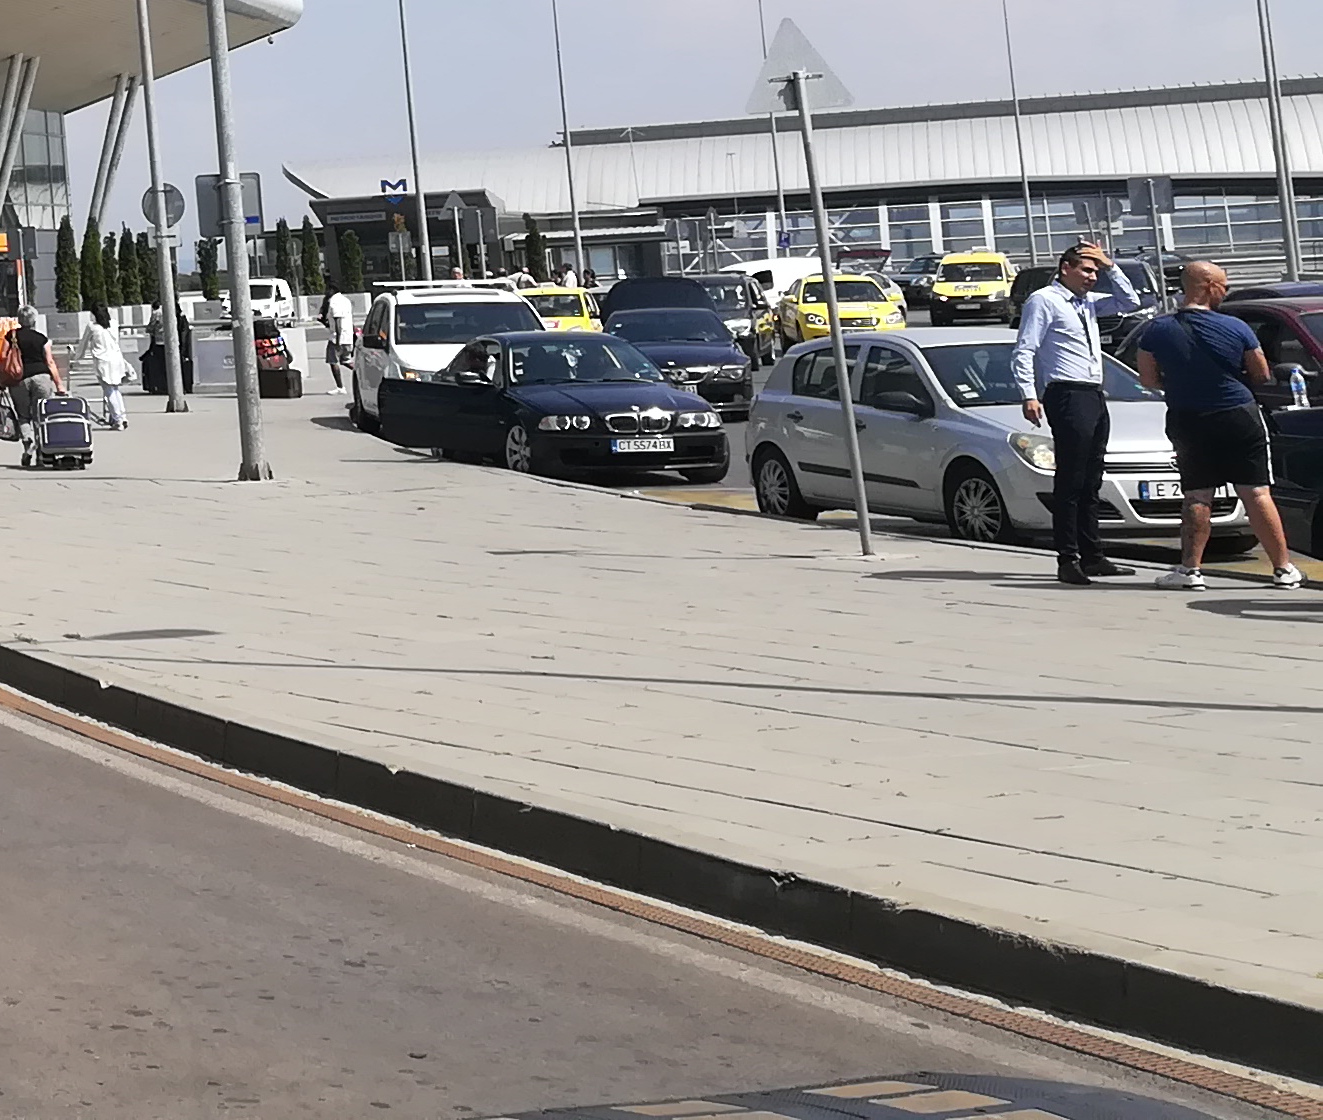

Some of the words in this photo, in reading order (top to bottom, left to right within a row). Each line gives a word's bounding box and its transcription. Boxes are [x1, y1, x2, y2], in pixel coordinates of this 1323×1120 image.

[618, 440, 632, 451] CT
[633, 440, 658, 451] 5574
[1156, 483, 1165, 497] E
